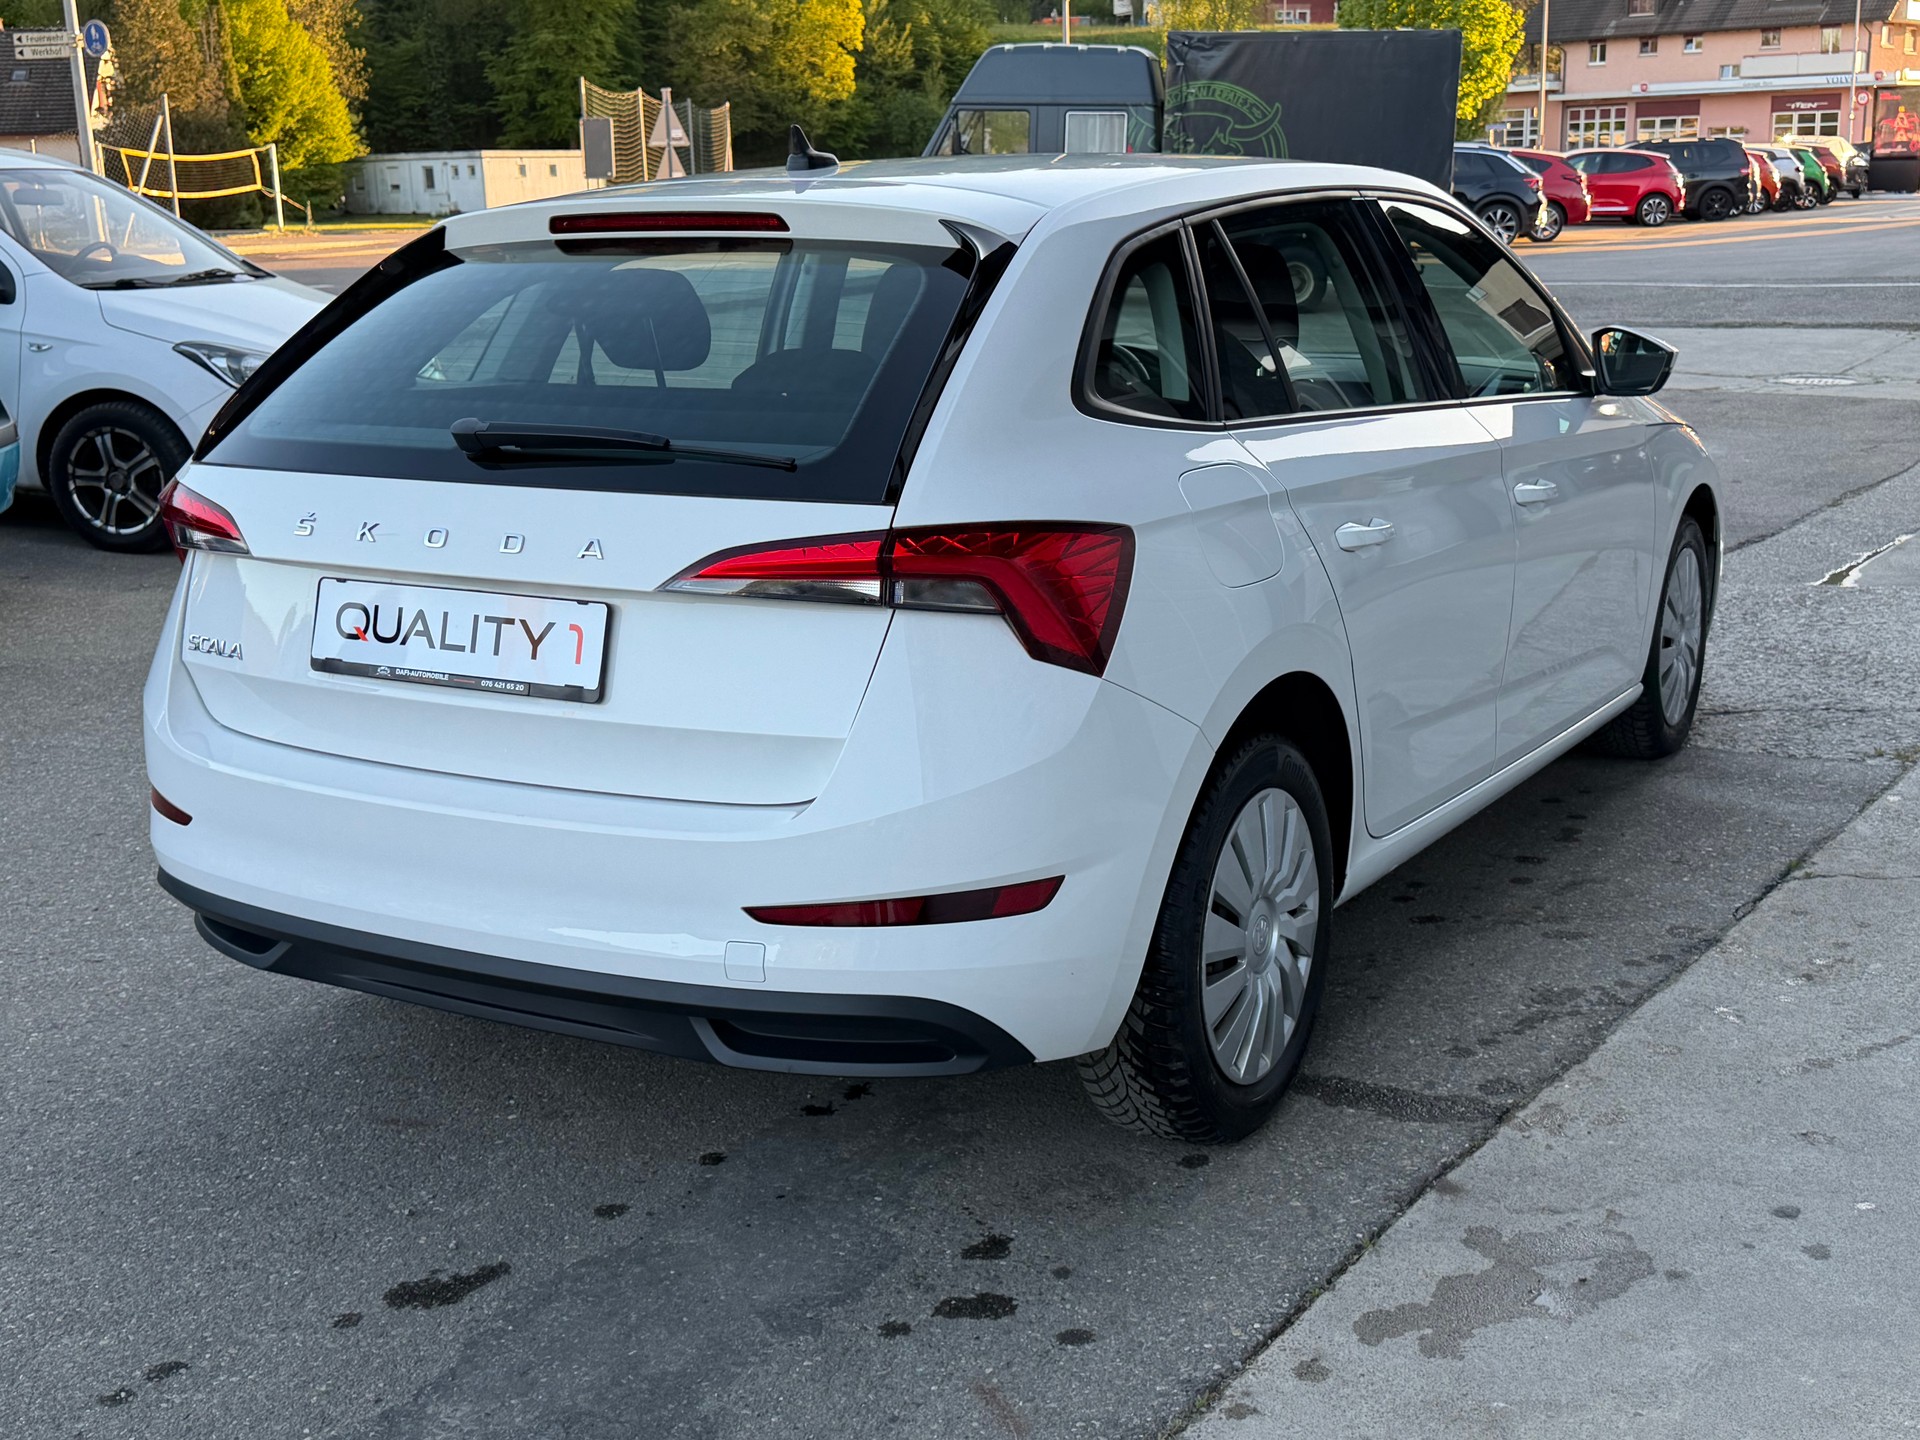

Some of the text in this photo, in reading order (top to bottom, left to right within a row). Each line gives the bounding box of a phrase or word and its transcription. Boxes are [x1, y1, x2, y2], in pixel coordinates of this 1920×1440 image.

[26, 34, 64, 43] Feuerwehr
[31, 47, 62, 56] Werkhof
[293, 511, 604, 560] ŠKODA
[335, 602, 557, 661] QUALITY
[188, 634, 243, 661] SCALA
[395, 668, 449, 681] DAFI-AUTOMOBILE
[494, 681, 505, 689] 421
